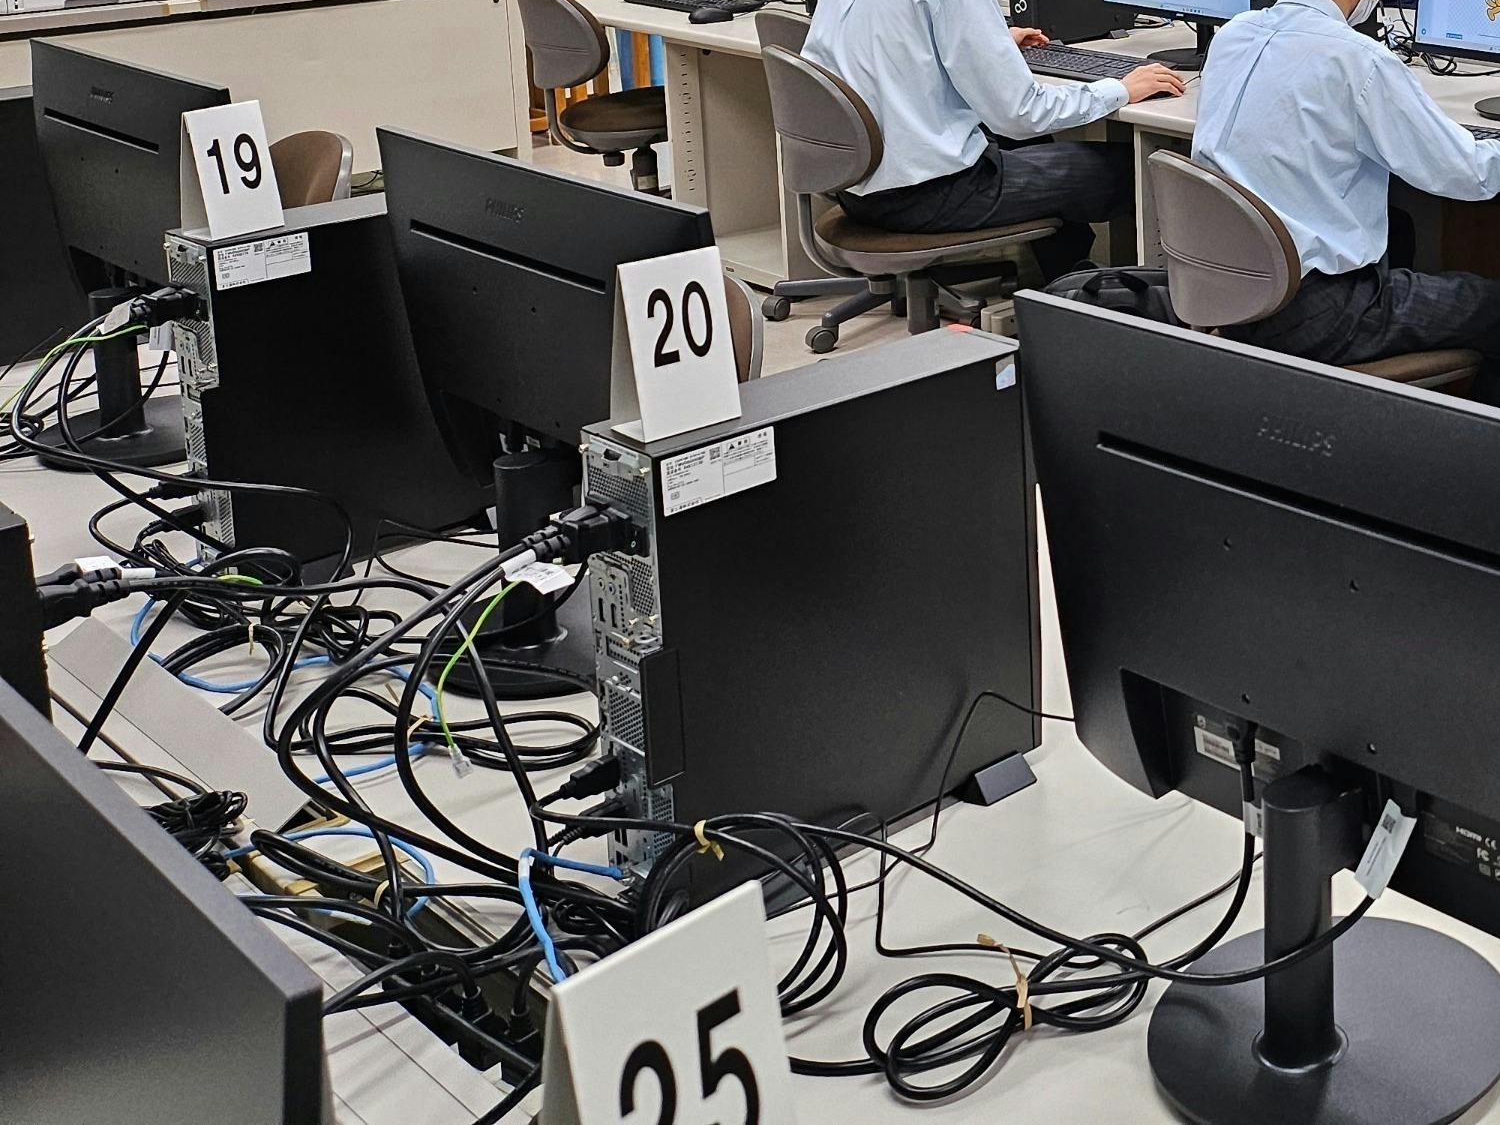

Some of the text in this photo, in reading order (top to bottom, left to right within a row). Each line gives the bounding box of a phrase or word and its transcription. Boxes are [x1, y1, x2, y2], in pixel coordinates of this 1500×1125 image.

[206, 132, 262, 195] 19
[647, 280, 713, 368] 20
[1257, 413, 1337, 458] PHILIPS
[619, 986, 761, 1125] 25
